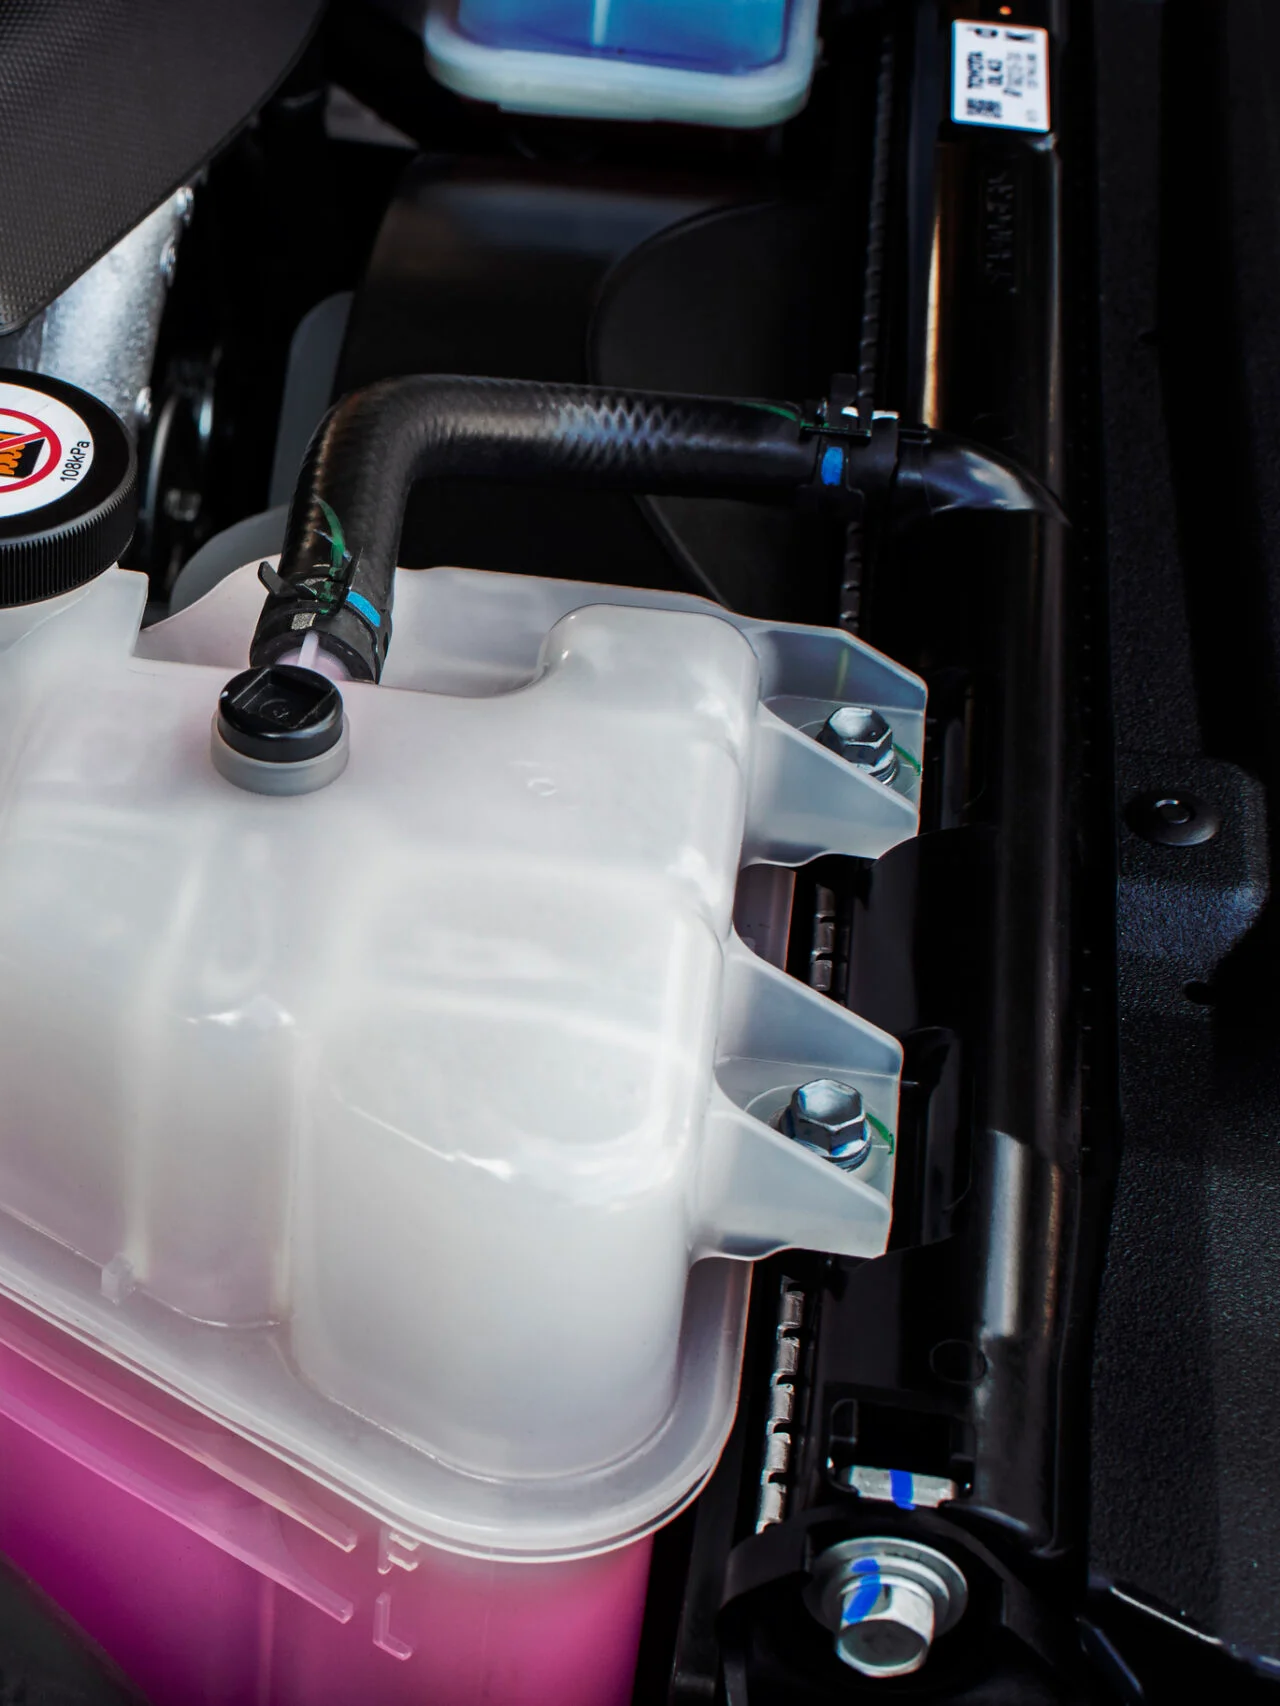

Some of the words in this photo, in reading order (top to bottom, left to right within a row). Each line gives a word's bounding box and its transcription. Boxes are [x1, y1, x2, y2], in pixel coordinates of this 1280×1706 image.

[60, 440, 91, 482] 108kPa
[377, 1526, 419, 1575] F
[372, 1592, 413, 1661] L
